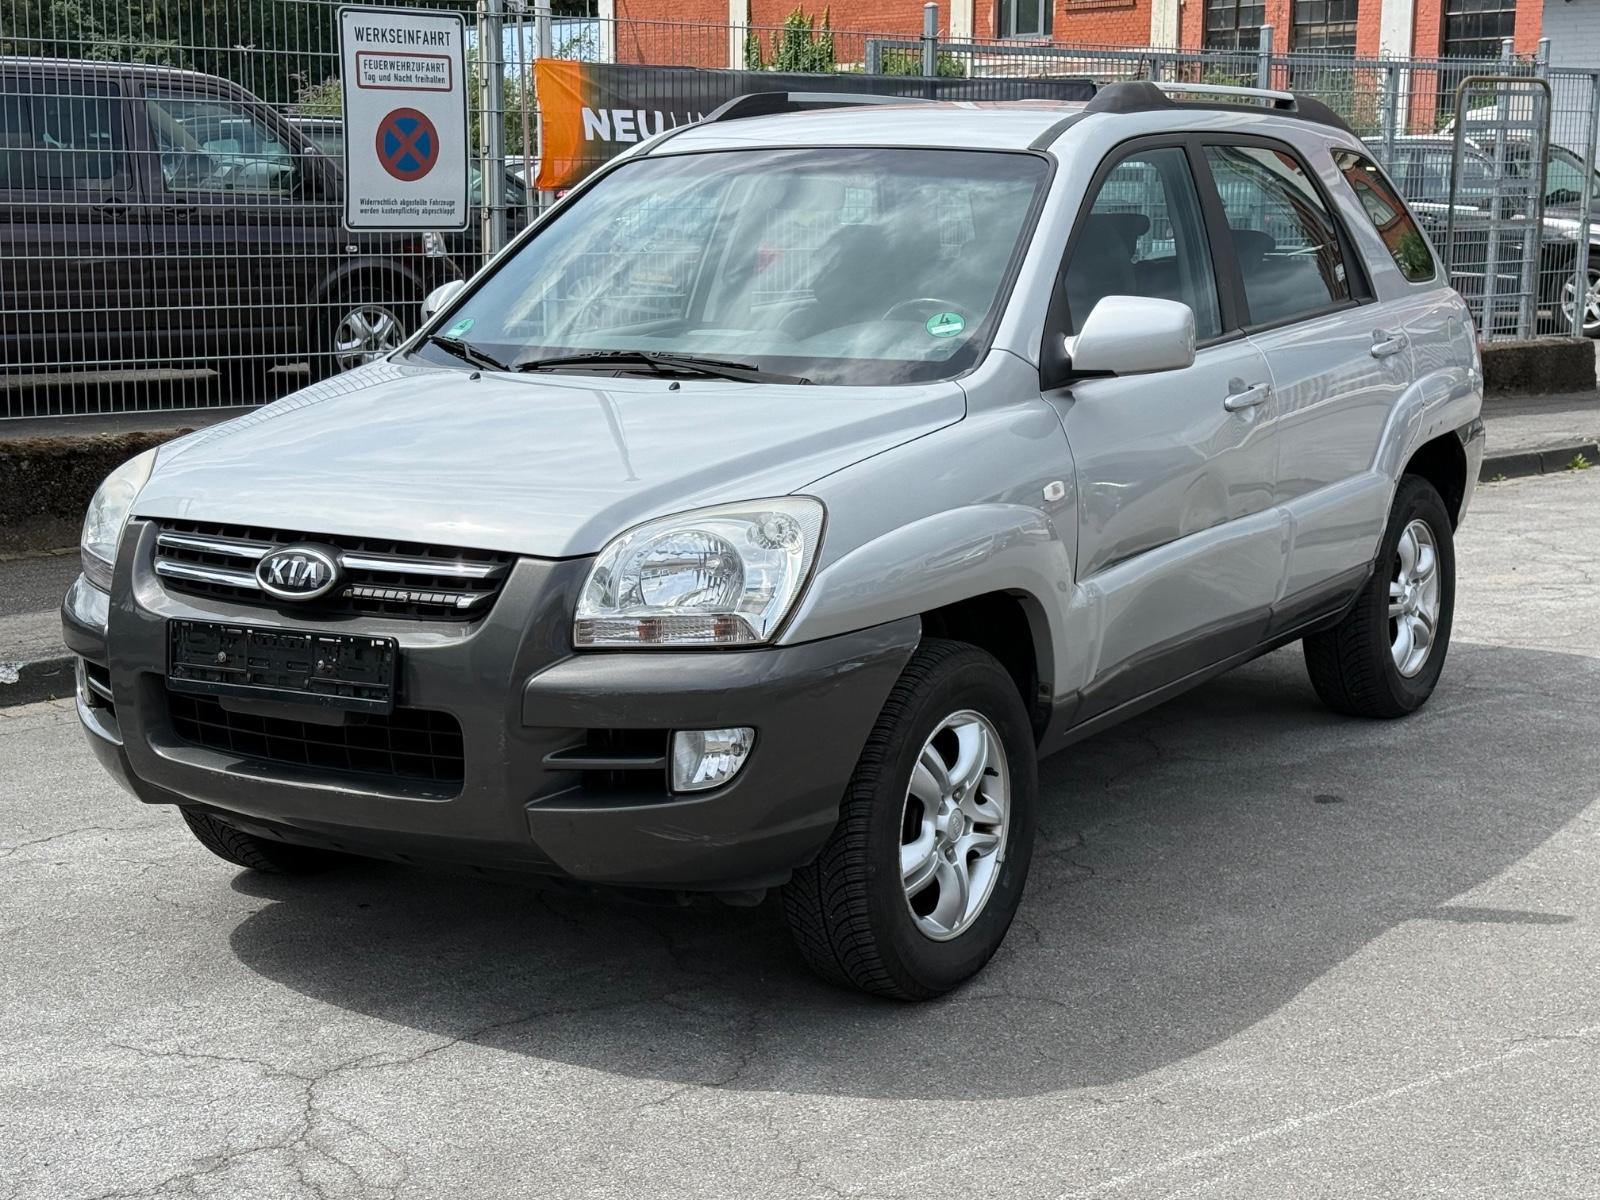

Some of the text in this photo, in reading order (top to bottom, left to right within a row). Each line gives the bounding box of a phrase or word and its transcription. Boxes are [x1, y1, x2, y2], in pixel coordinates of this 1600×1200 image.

[354, 26, 451, 46] WERKSEINFAHRT
[363, 59, 445, 72] FEUERWEHRZUFAHRT
[364, 72, 446, 84] Tag und Nacht freihalten
[581, 107, 665, 142] NEU
[360, 198, 456, 207] Widerrechtlich abgestellte Fahrzeuge
[381, 207, 420, 216] kostenpflichtig
[421, 207, 456, 216] abgeschleppt
[267, 556, 324, 588] KIA
